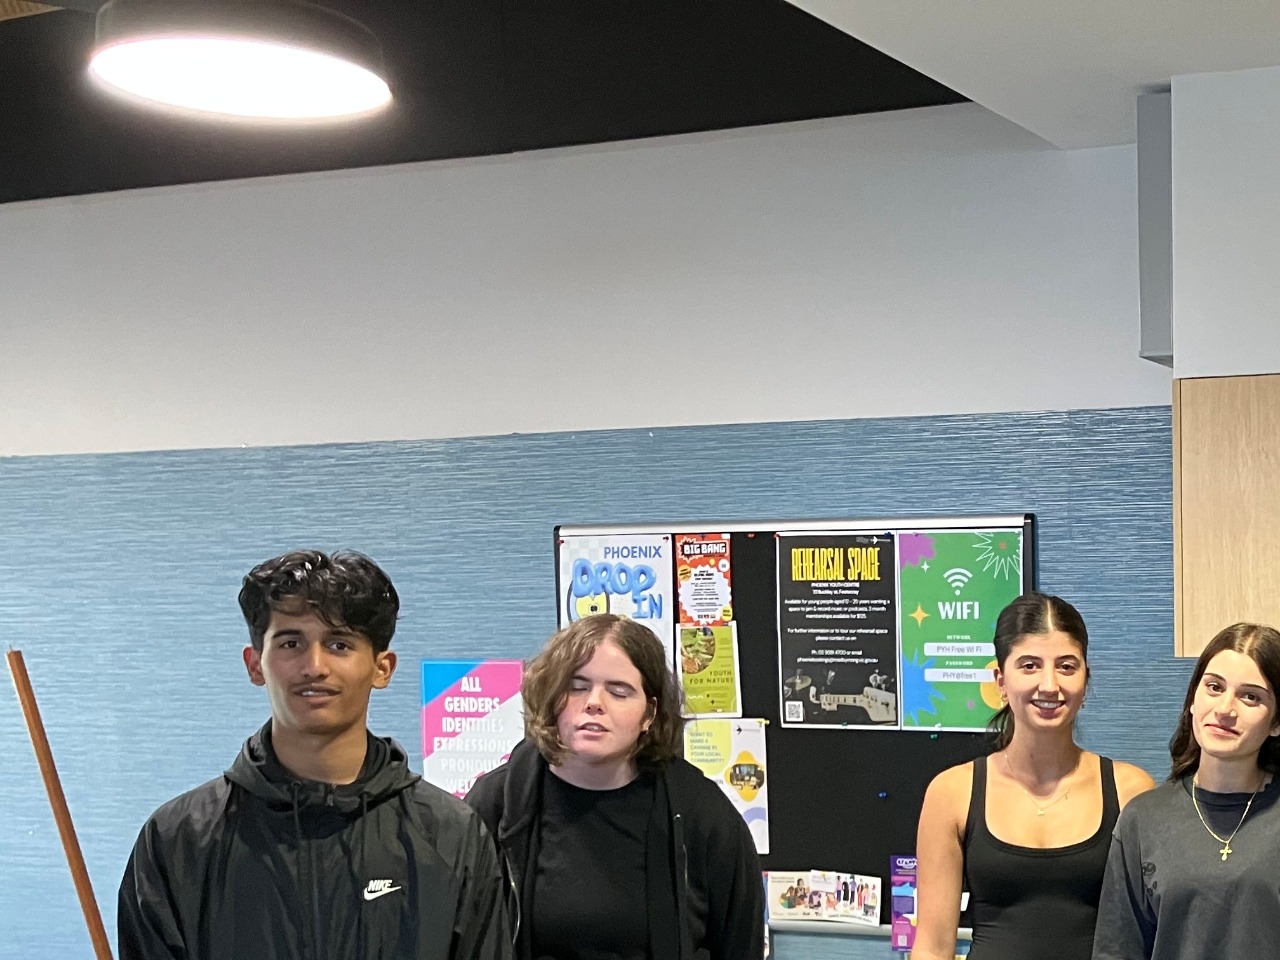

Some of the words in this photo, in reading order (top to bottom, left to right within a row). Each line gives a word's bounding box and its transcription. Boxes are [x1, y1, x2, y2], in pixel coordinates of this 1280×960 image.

[603, 545, 662, 559] PHOENIX
[683, 544, 701, 555] BIG
[701, 543, 726, 554] BANG
[792, 547, 845, 581] REHEARSAL
[847, 547, 881, 581] SPACE
[572, 557, 656, 599] DROP
[632, 594, 663, 619] IN
[937, 601, 980, 620] WIFI
[936, 645, 951, 653] PYH
[951, 645, 966, 653] Free
[460, 676, 482, 692] ALL
[444, 697, 500, 713] GENDERS
[442, 717, 504, 733] IDENTITIES
[433, 736, 512, 753] EXPRESSIONS
[440, 757, 507, 772] PRONOUN
[367, 879, 393, 892] NIKE
